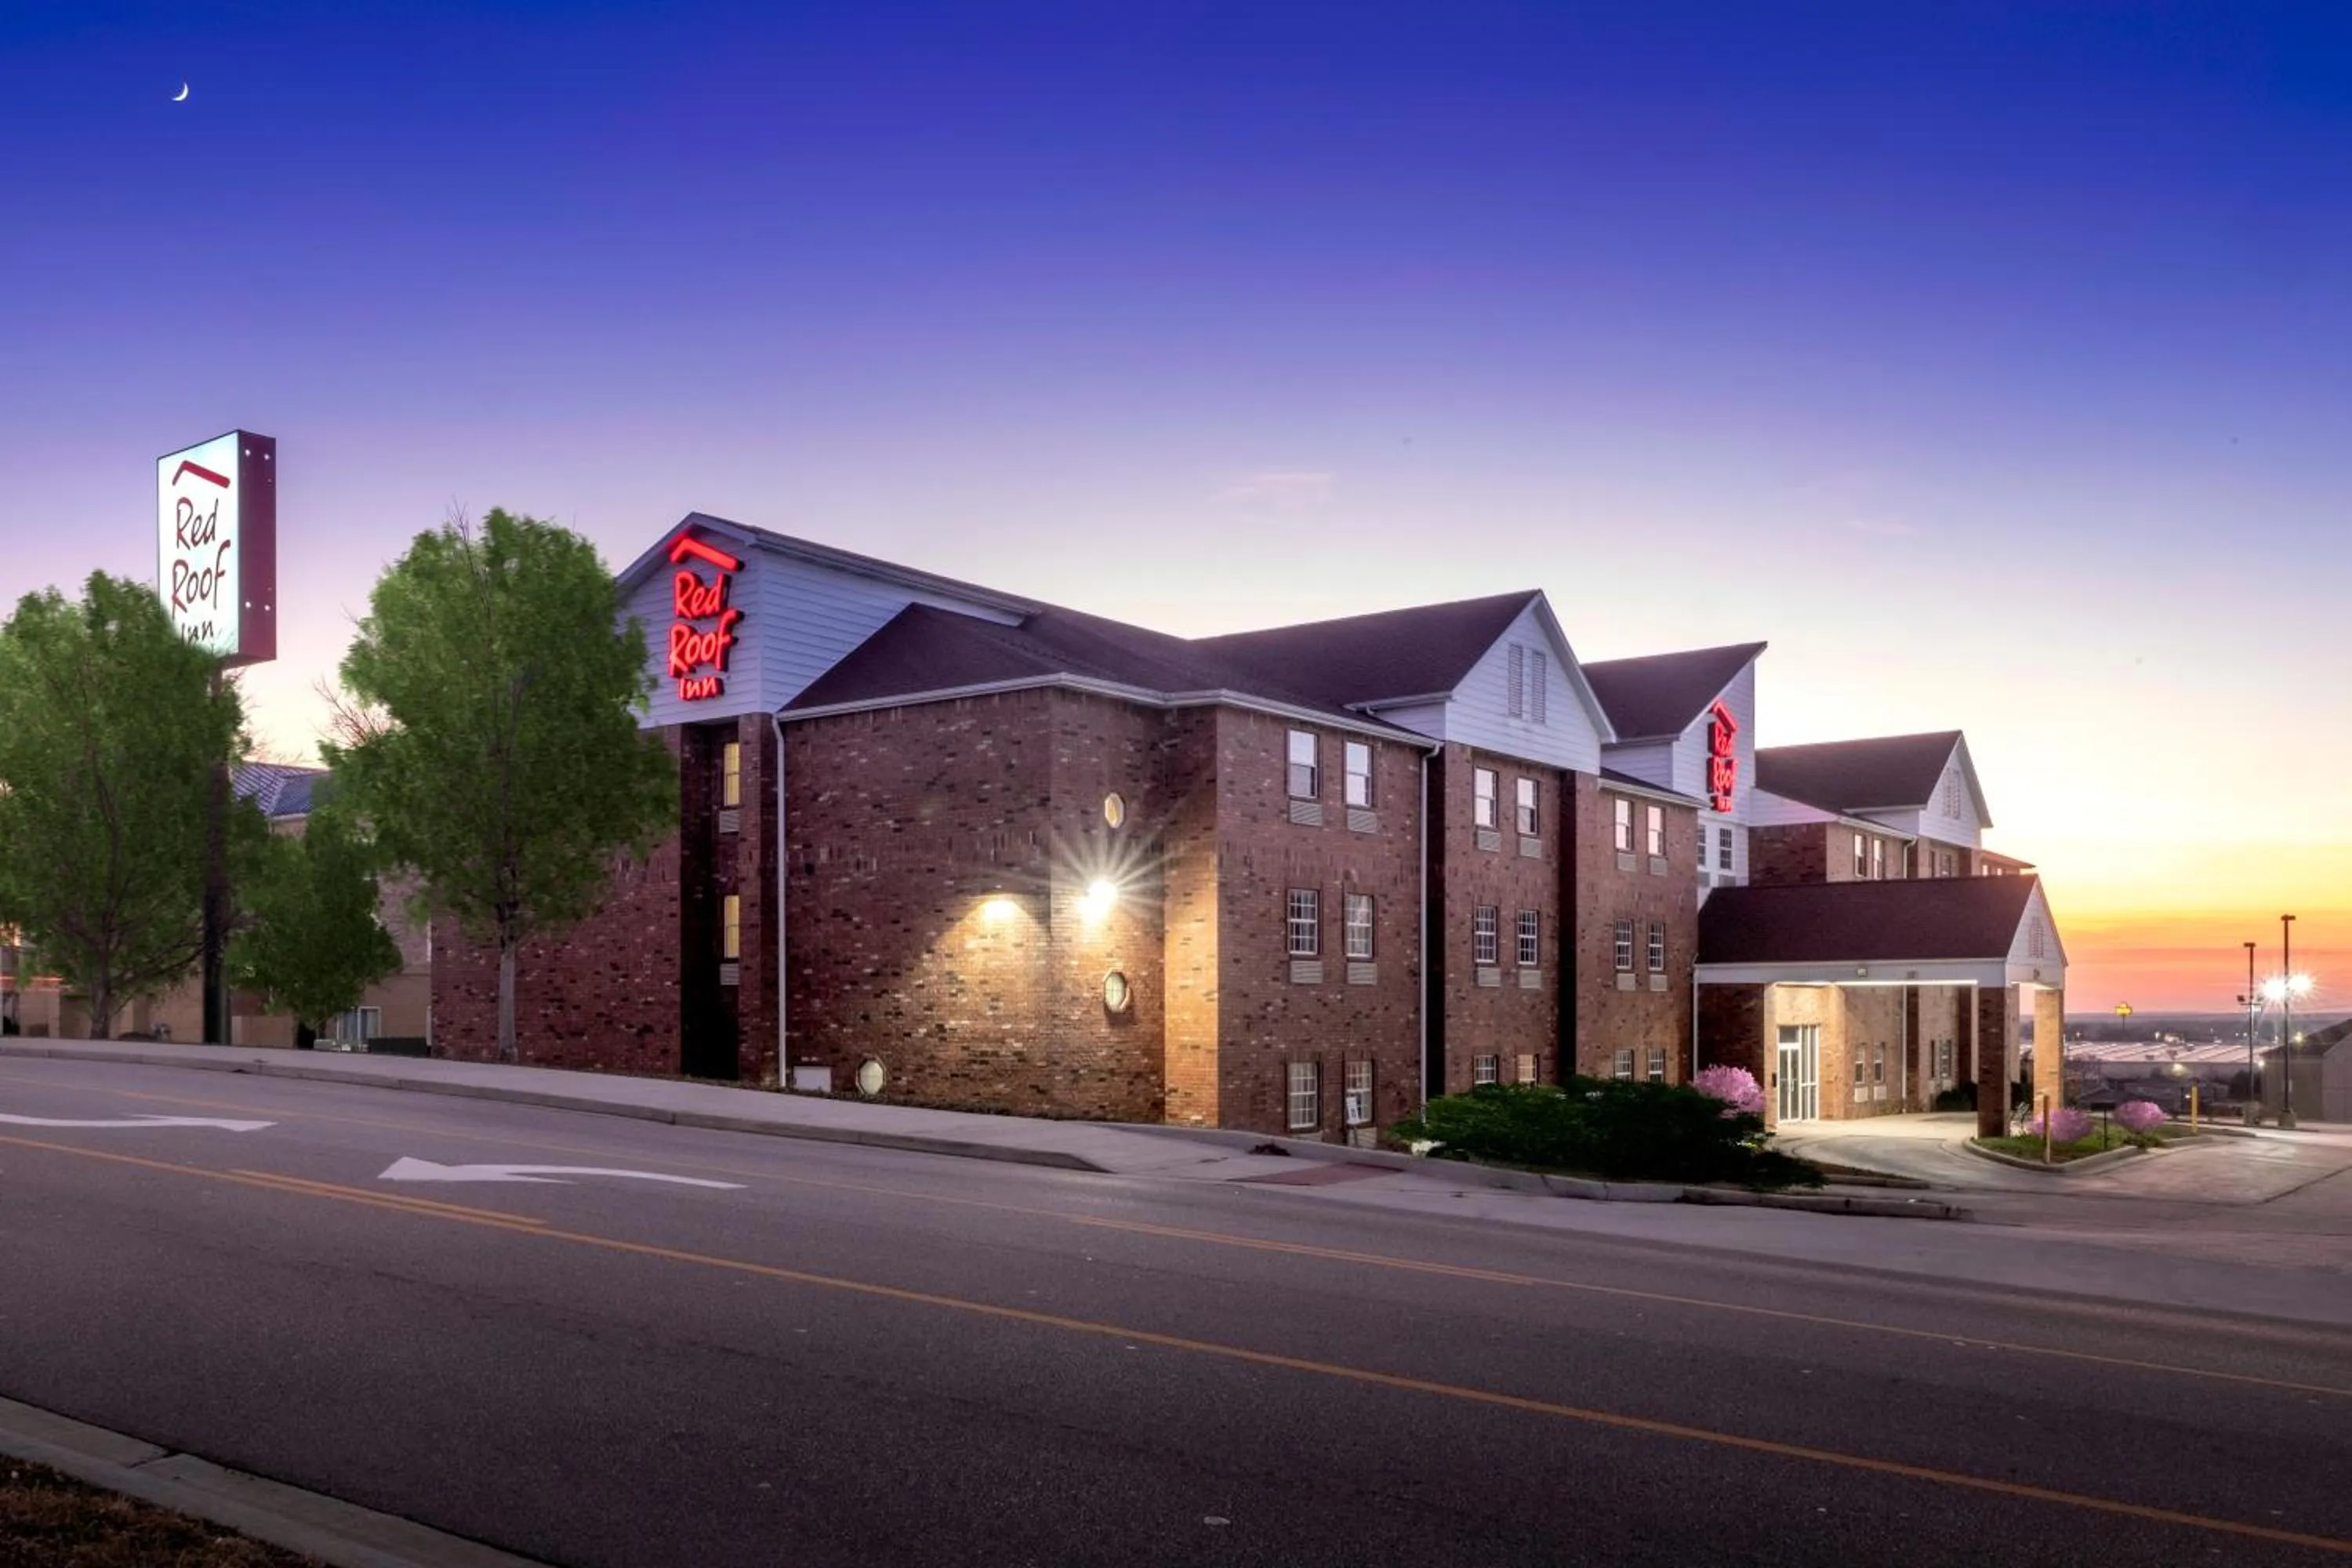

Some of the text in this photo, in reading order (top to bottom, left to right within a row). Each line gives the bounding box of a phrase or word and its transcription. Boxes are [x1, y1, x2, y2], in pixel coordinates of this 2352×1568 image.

[176, 496, 219, 550] Red
[172, 539, 231, 620] Roof
[674, 570, 728, 619] Red
[669, 608, 741, 677] Roof
[678, 677, 722, 700] Inn
